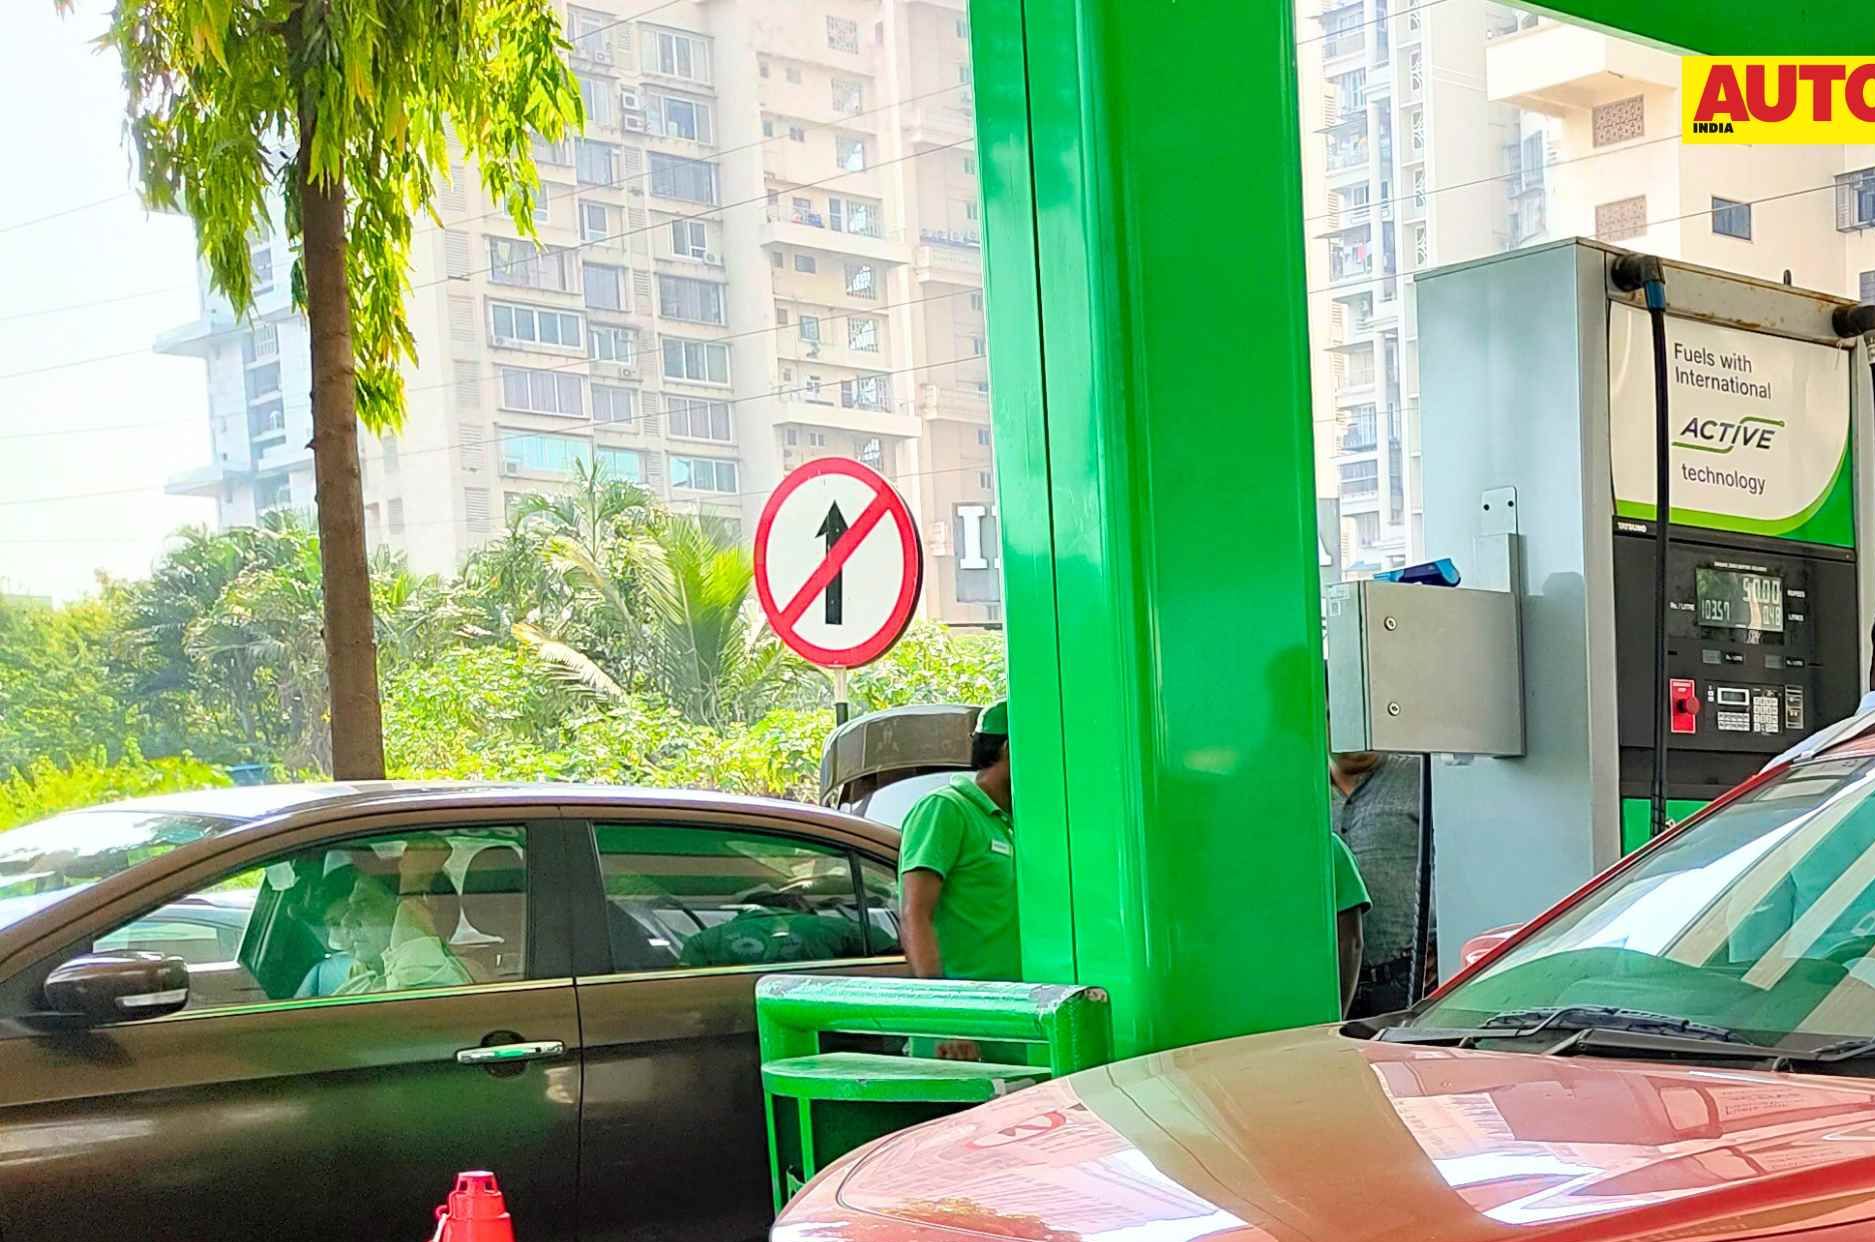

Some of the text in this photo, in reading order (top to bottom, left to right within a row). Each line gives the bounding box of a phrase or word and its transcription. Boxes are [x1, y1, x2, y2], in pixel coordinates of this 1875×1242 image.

[1673, 342, 1752, 374] Fuels with
[1674, 366, 1772, 400] International
[1679, 416, 1776, 450] ACTIVE
[1681, 463, 1766, 495] technology
